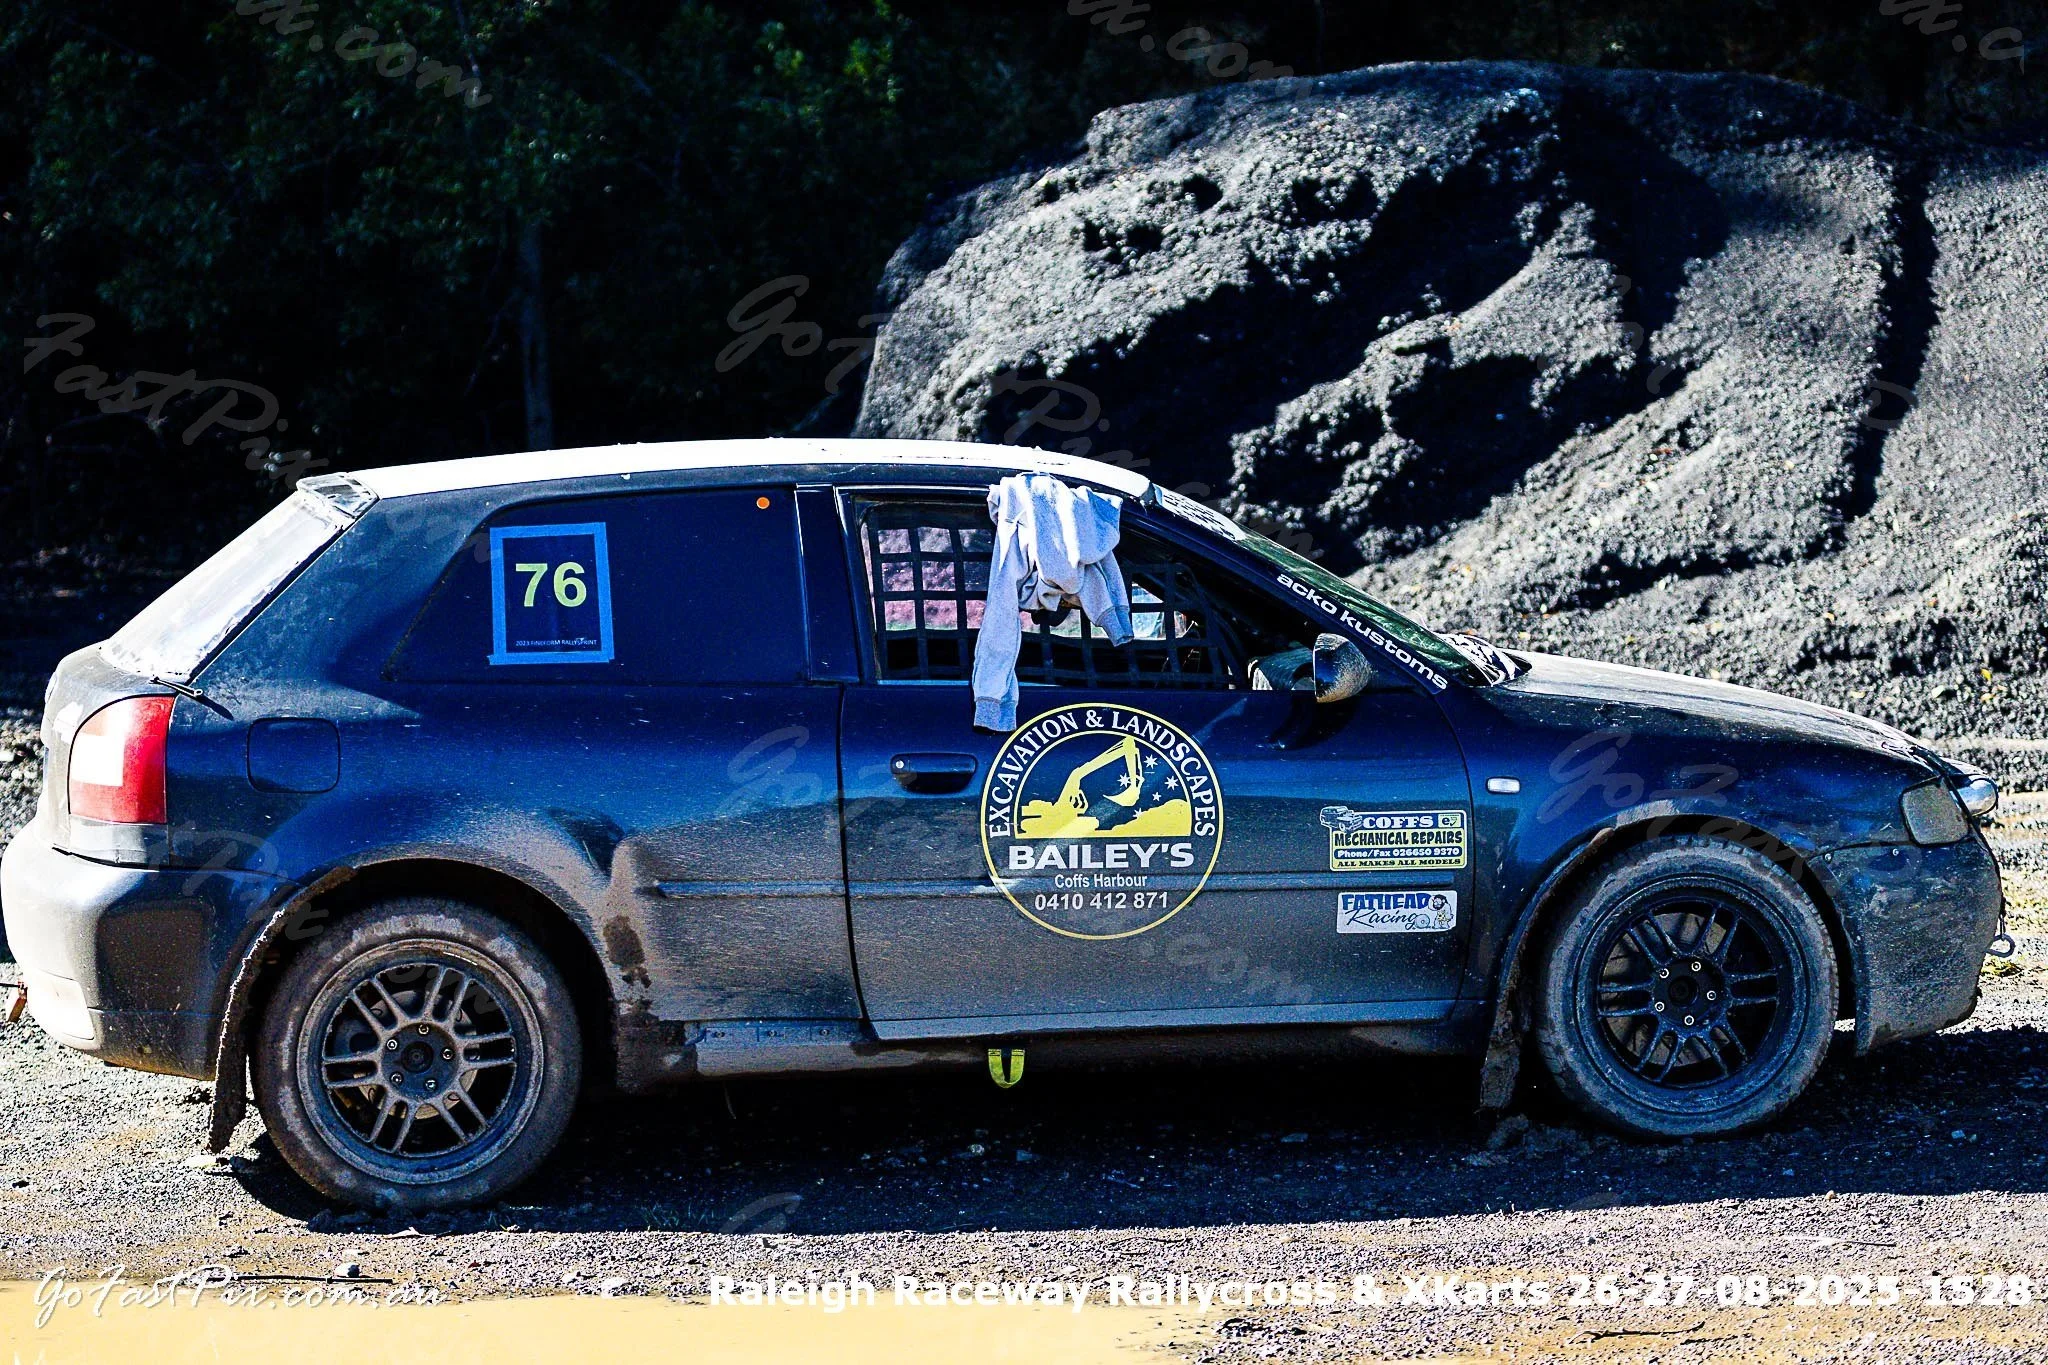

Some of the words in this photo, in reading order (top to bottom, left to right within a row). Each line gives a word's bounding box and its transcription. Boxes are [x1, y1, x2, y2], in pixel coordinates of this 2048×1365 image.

[516, 562, 587, 607] 76
[1276, 573, 1337, 615] acko
[1339, 609, 1449, 691] kustoms
[989, 712, 1079, 838] EXCAVATION
[1085, 709, 1104, 728] &
[1112, 711, 1216, 837] LANDSCAPES
[1362, 815, 1434, 829] COFFS
[1334, 831, 1409, 847] MECHANICAL
[1411, 830, 1463, 845] REPAIRS
[1008, 843, 1195, 870] BAILEY'S
[1337, 849, 1391, 858] Phone/Fax
[1433, 847, 1460, 857] 9370
[1419, 858, 1461, 866] MODELS
[1054, 874, 1090, 889] Coffs
[1093, 873, 1148, 888] Harbour
[1034, 894, 1084, 911] 0410
[1090, 893, 1127, 910] 412
[1134, 892, 1168, 908] 871
[1341, 893, 1432, 911] FATHEAD
[1345, 908, 1418, 930] Racing
